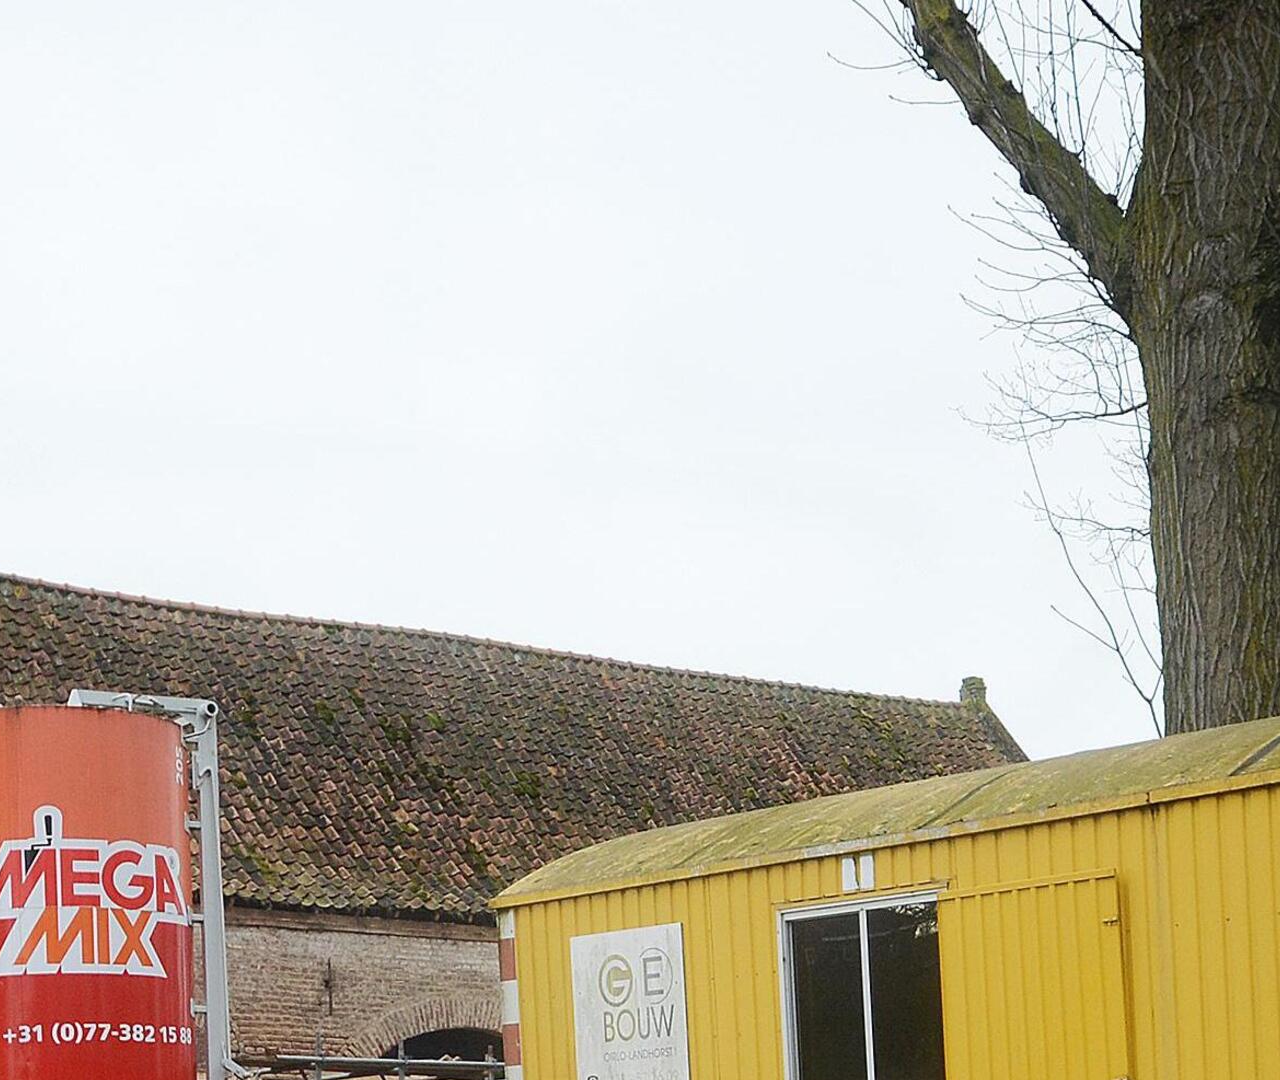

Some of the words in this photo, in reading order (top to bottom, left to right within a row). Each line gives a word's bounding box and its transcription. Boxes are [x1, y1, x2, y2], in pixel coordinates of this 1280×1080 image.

[14, 906, 153, 967] MIX
[3, 1024, 43, 1044] +31
[51, 1022, 156, 1045] (0)77-382
[160, 1026, 178, 1044] 15
[180, 1027, 192, 1045] 88
[604, 1004, 674, 1043] BOUW
